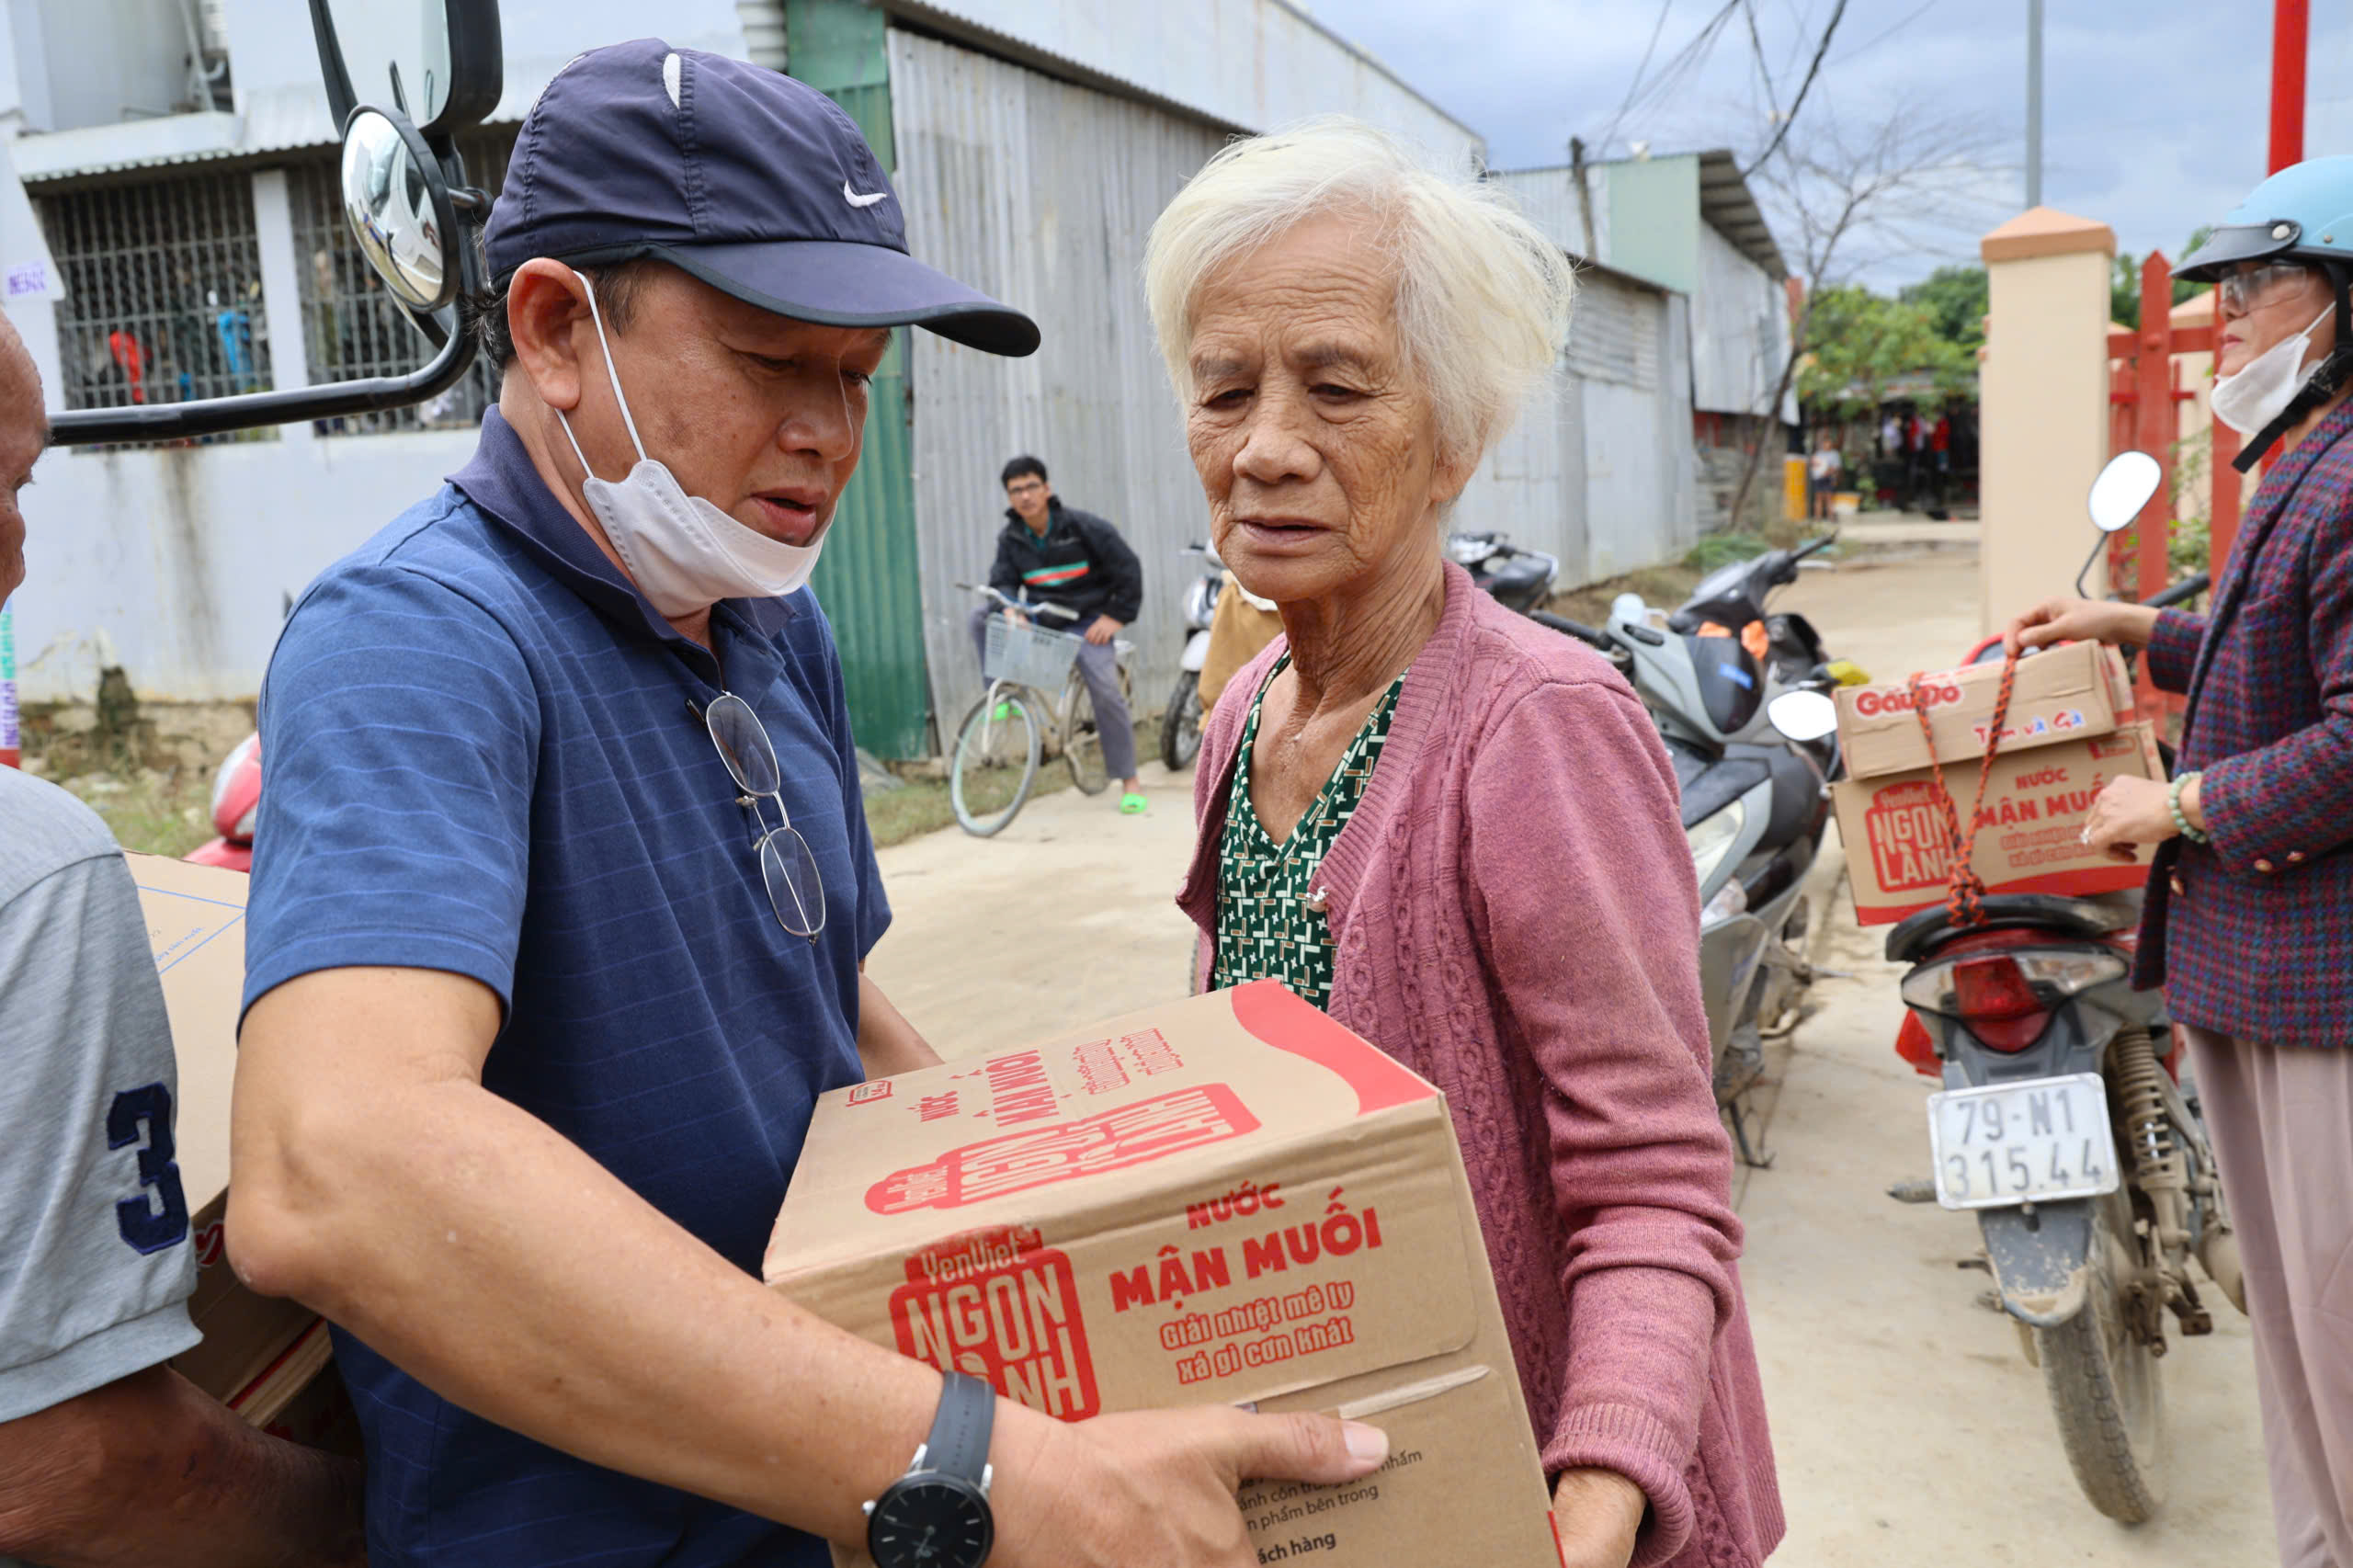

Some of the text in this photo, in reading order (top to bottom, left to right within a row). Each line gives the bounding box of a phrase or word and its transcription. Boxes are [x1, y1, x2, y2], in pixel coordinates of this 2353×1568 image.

[2046, 772, 2103, 817] MU
[1957, 1089, 2075, 1145] 79-N1
[107, 1081, 189, 1256] 3
[1948, 1139, 2101, 1200] 315.44
[1186, 1181, 1286, 1230] NƯỚC
[922, 1231, 1028, 1286] YenViet
[1108, 1186, 1383, 1313] MẬN MUỐI
[904, 1263, 1067, 1372] NGON
[1160, 1280, 1355, 1350] Giải nhiệt mê ly
[1176, 1317, 1355, 1385] xá gì cơn khát
[1338, 1484, 1379, 1507] trong
[1256, 1532, 1337, 1564] ách hàng
